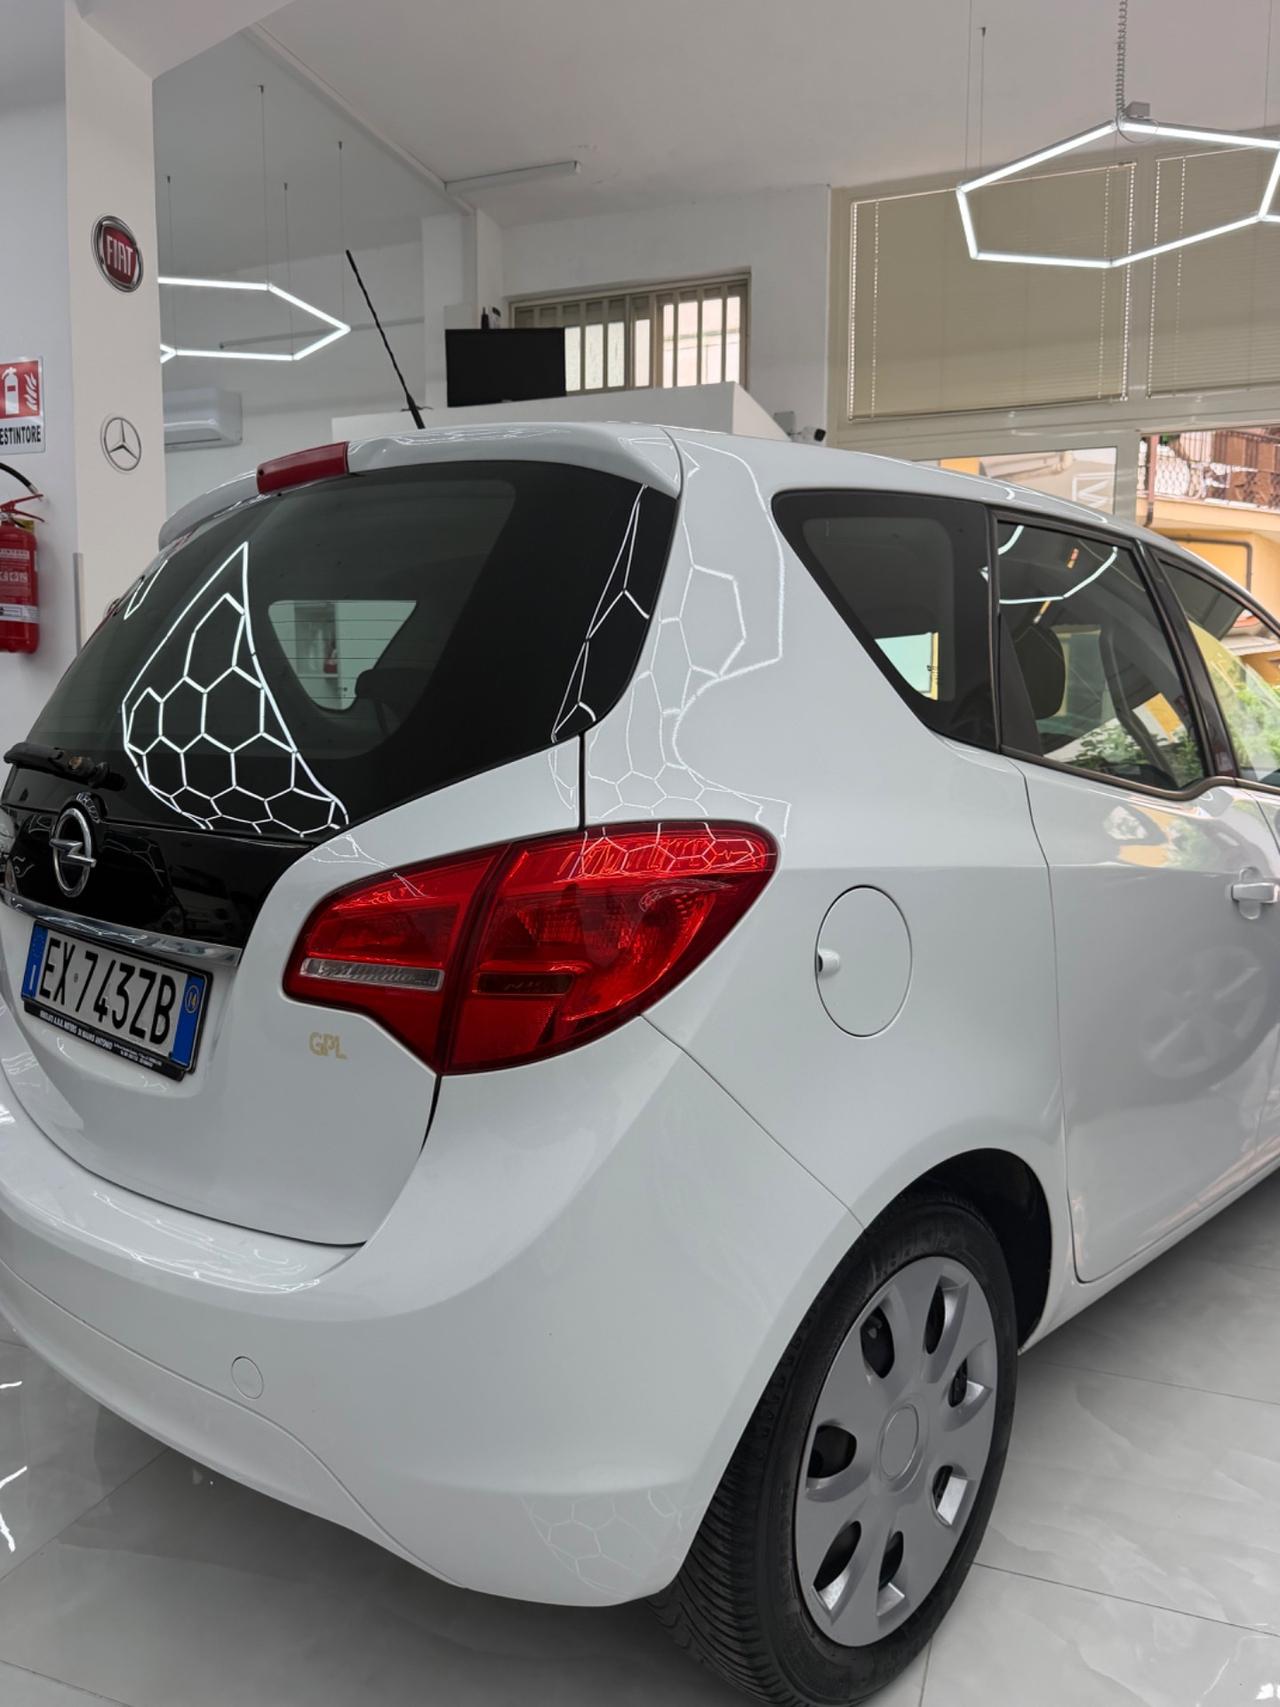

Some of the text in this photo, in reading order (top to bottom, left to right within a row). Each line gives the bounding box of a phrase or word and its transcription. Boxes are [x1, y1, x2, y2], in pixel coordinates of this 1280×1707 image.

[106, 234, 133, 276] FIAT
[0, 425, 41, 445] ESTINTORE
[309, 1031, 348, 1060] GPL
